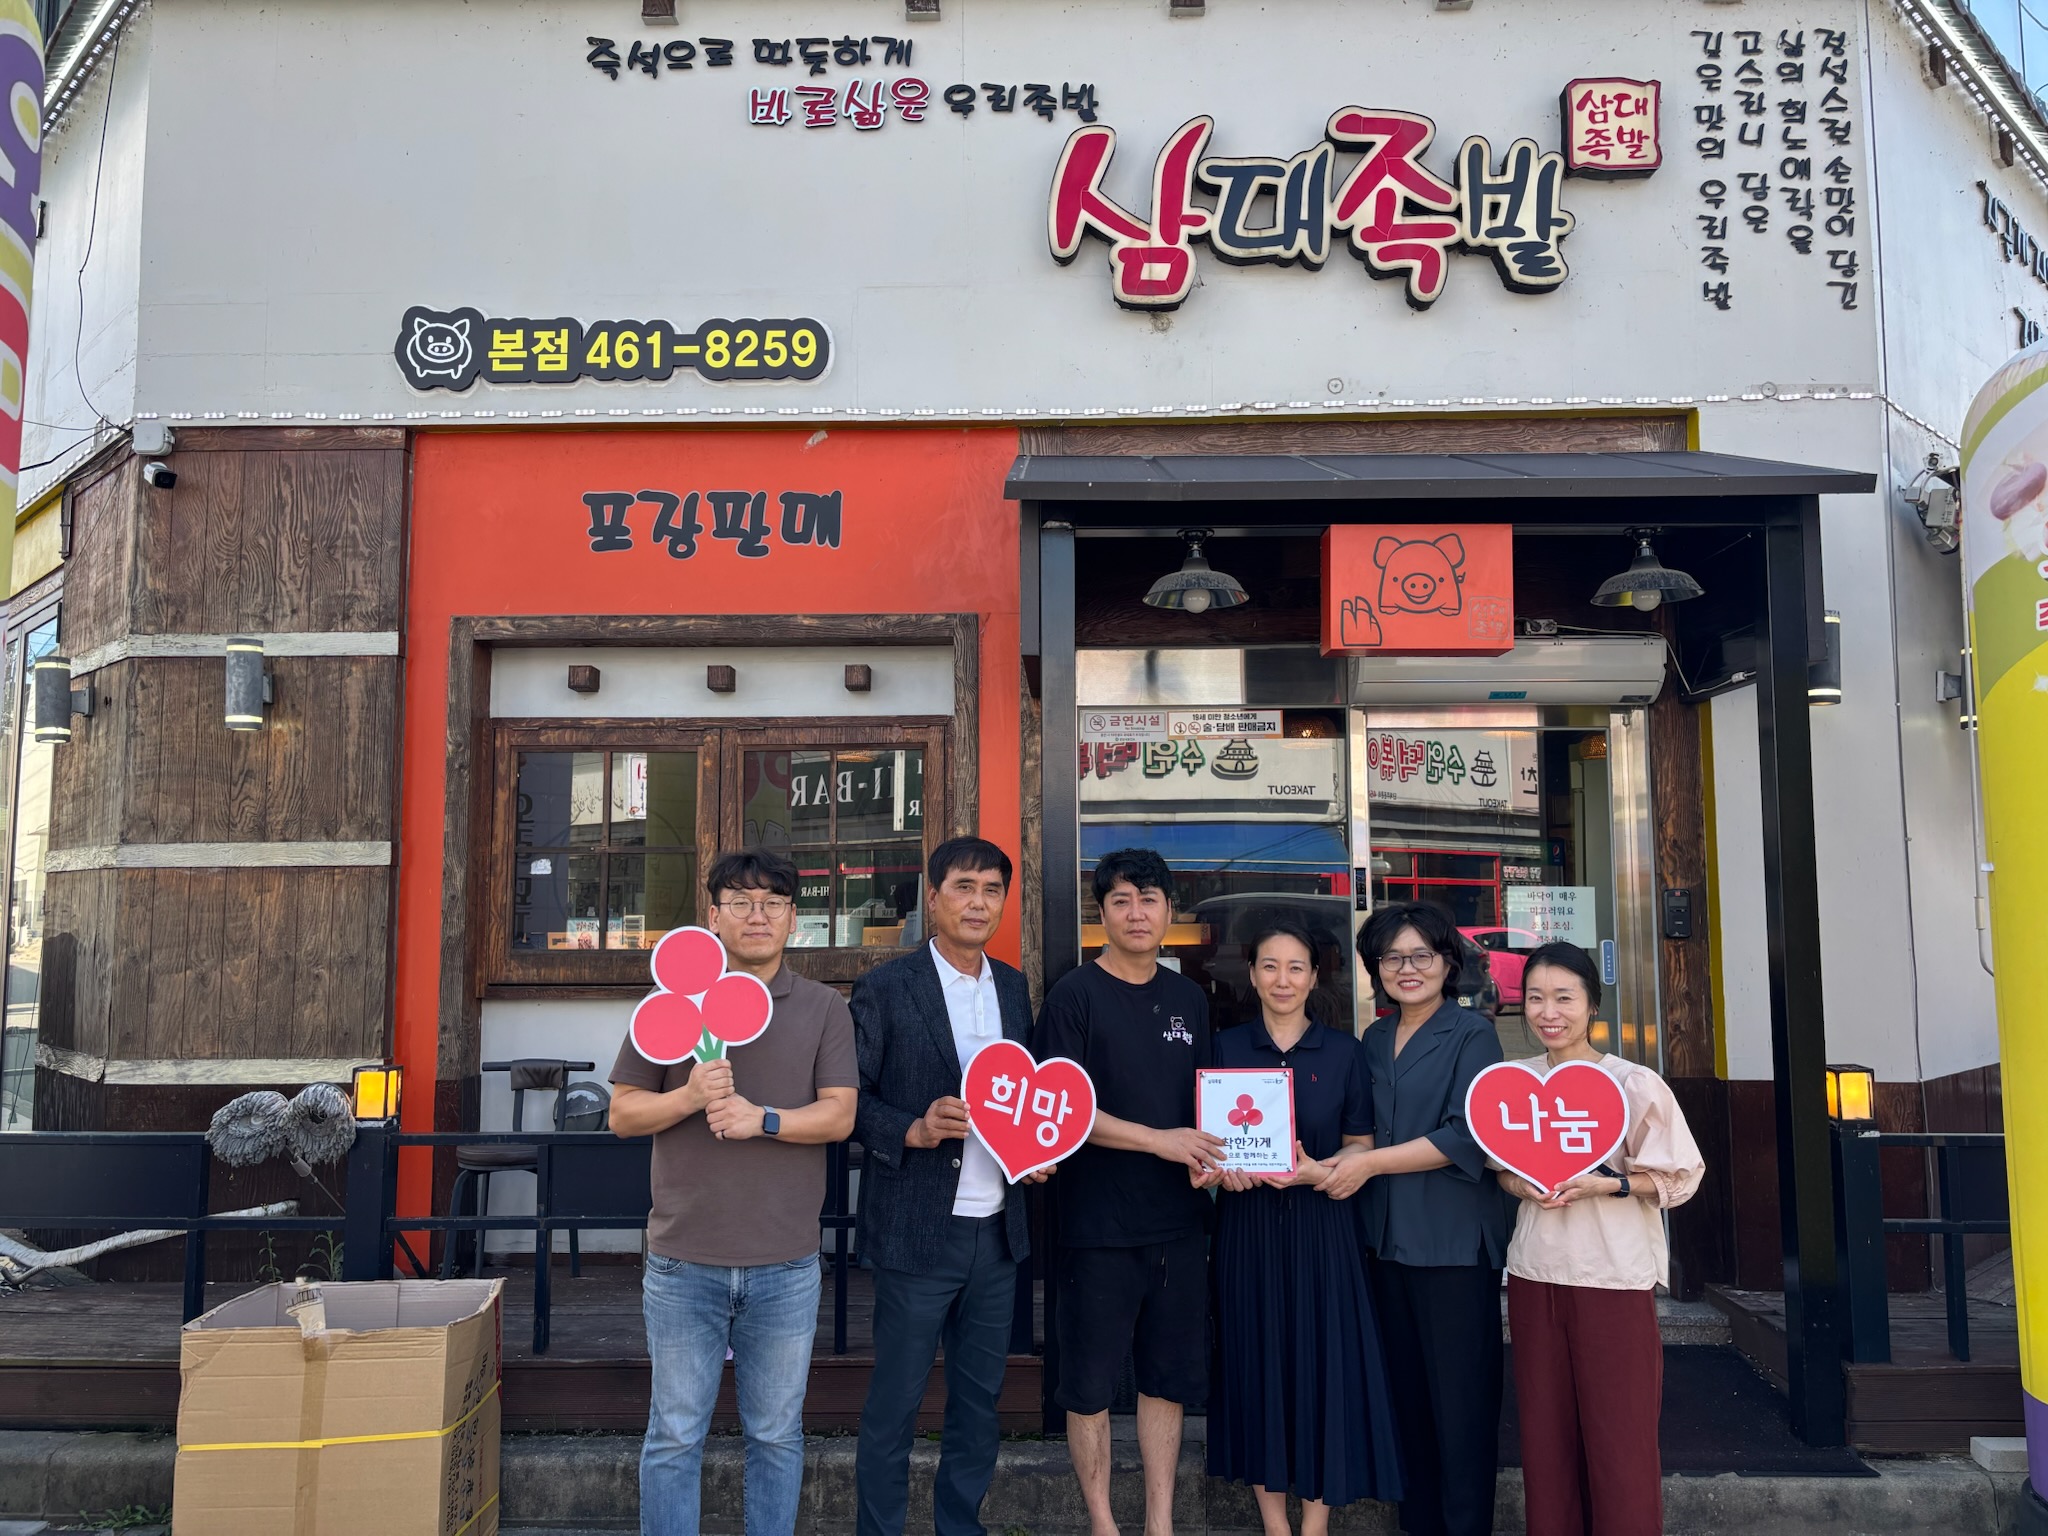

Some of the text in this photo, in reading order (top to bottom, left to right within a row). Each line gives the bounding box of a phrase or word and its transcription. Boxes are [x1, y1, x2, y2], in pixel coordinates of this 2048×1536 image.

[586, 35, 913, 79] 즉석으로 따뜻하게
[748, 77, 1100, 130] 바로삶은 우리족발
[1576, 90, 1649, 124] 삼대
[1578, 127, 1650, 161] 족발
[1733, 30, 1772, 234] 고스라니 담은
[1776, 29, 1816, 255] 삶의 희노애락을
[1690, 30, 1733, 311] 깊은 맛의 우리족발
[1052, 108, 1573, 303] 삼대족발
[1823, 155, 1855, 238] 손맛이
[487, 328, 817, 372] 본점 461-8259
[582, 490, 843, 560] 포장판매
[1109, 714, 1160, 727] 금연시설
[1238, 722, 1276, 731] 판매금지
[1528, 891, 1577, 901] 바닥이 매우
[1529, 906, 1575, 916] 미끄러워요
[983, 1073, 1074, 1148] 희망
[1498, 1092, 1599, 1154] 나눔
[1222, 1136, 1271, 1149] 착한가게
[1243, 1152, 1269, 1160] 함께하는
[1271, 1152, 1278, 1160] 곳
